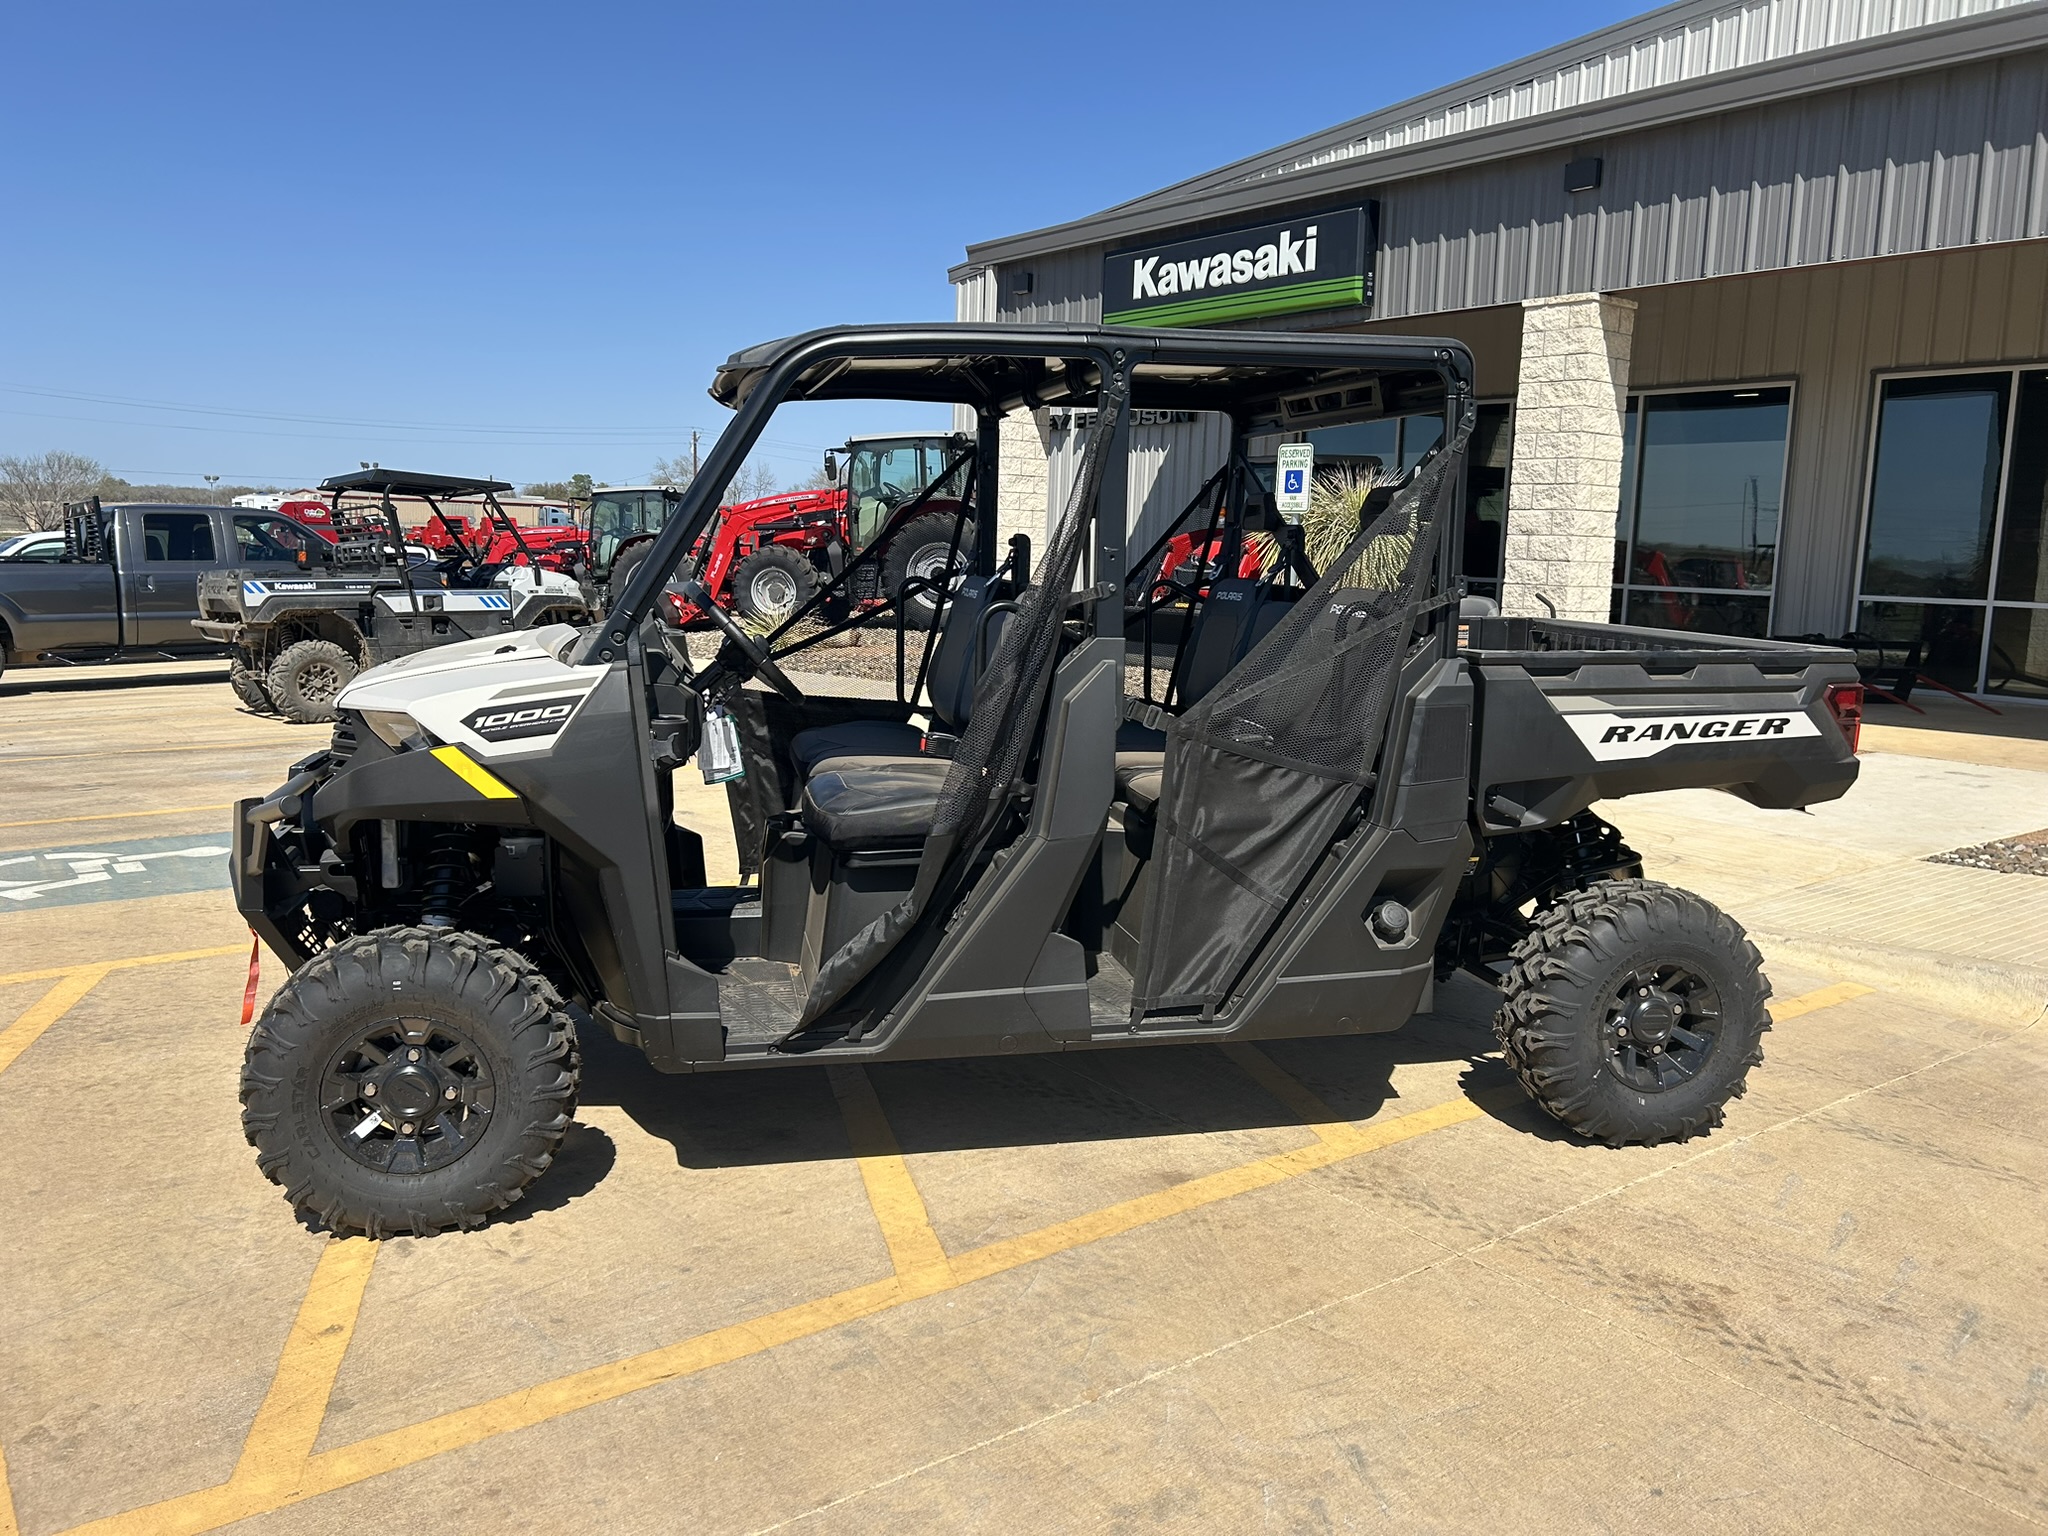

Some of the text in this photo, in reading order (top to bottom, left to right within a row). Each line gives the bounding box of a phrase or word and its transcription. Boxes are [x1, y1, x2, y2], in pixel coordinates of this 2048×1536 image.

[1132, 225, 1318, 300] Kawasaki
[1280, 448, 1311, 458] RESERVED
[1281, 460, 1308, 469] PARKING
[274, 582, 317, 590] Kawasaki
[1215, 591, 1244, 601] POLARIS
[473, 704, 572, 729] 1000
[1599, 718, 1791, 744] RANGER
[291, 1066, 321, 1160] CARLSTAR
